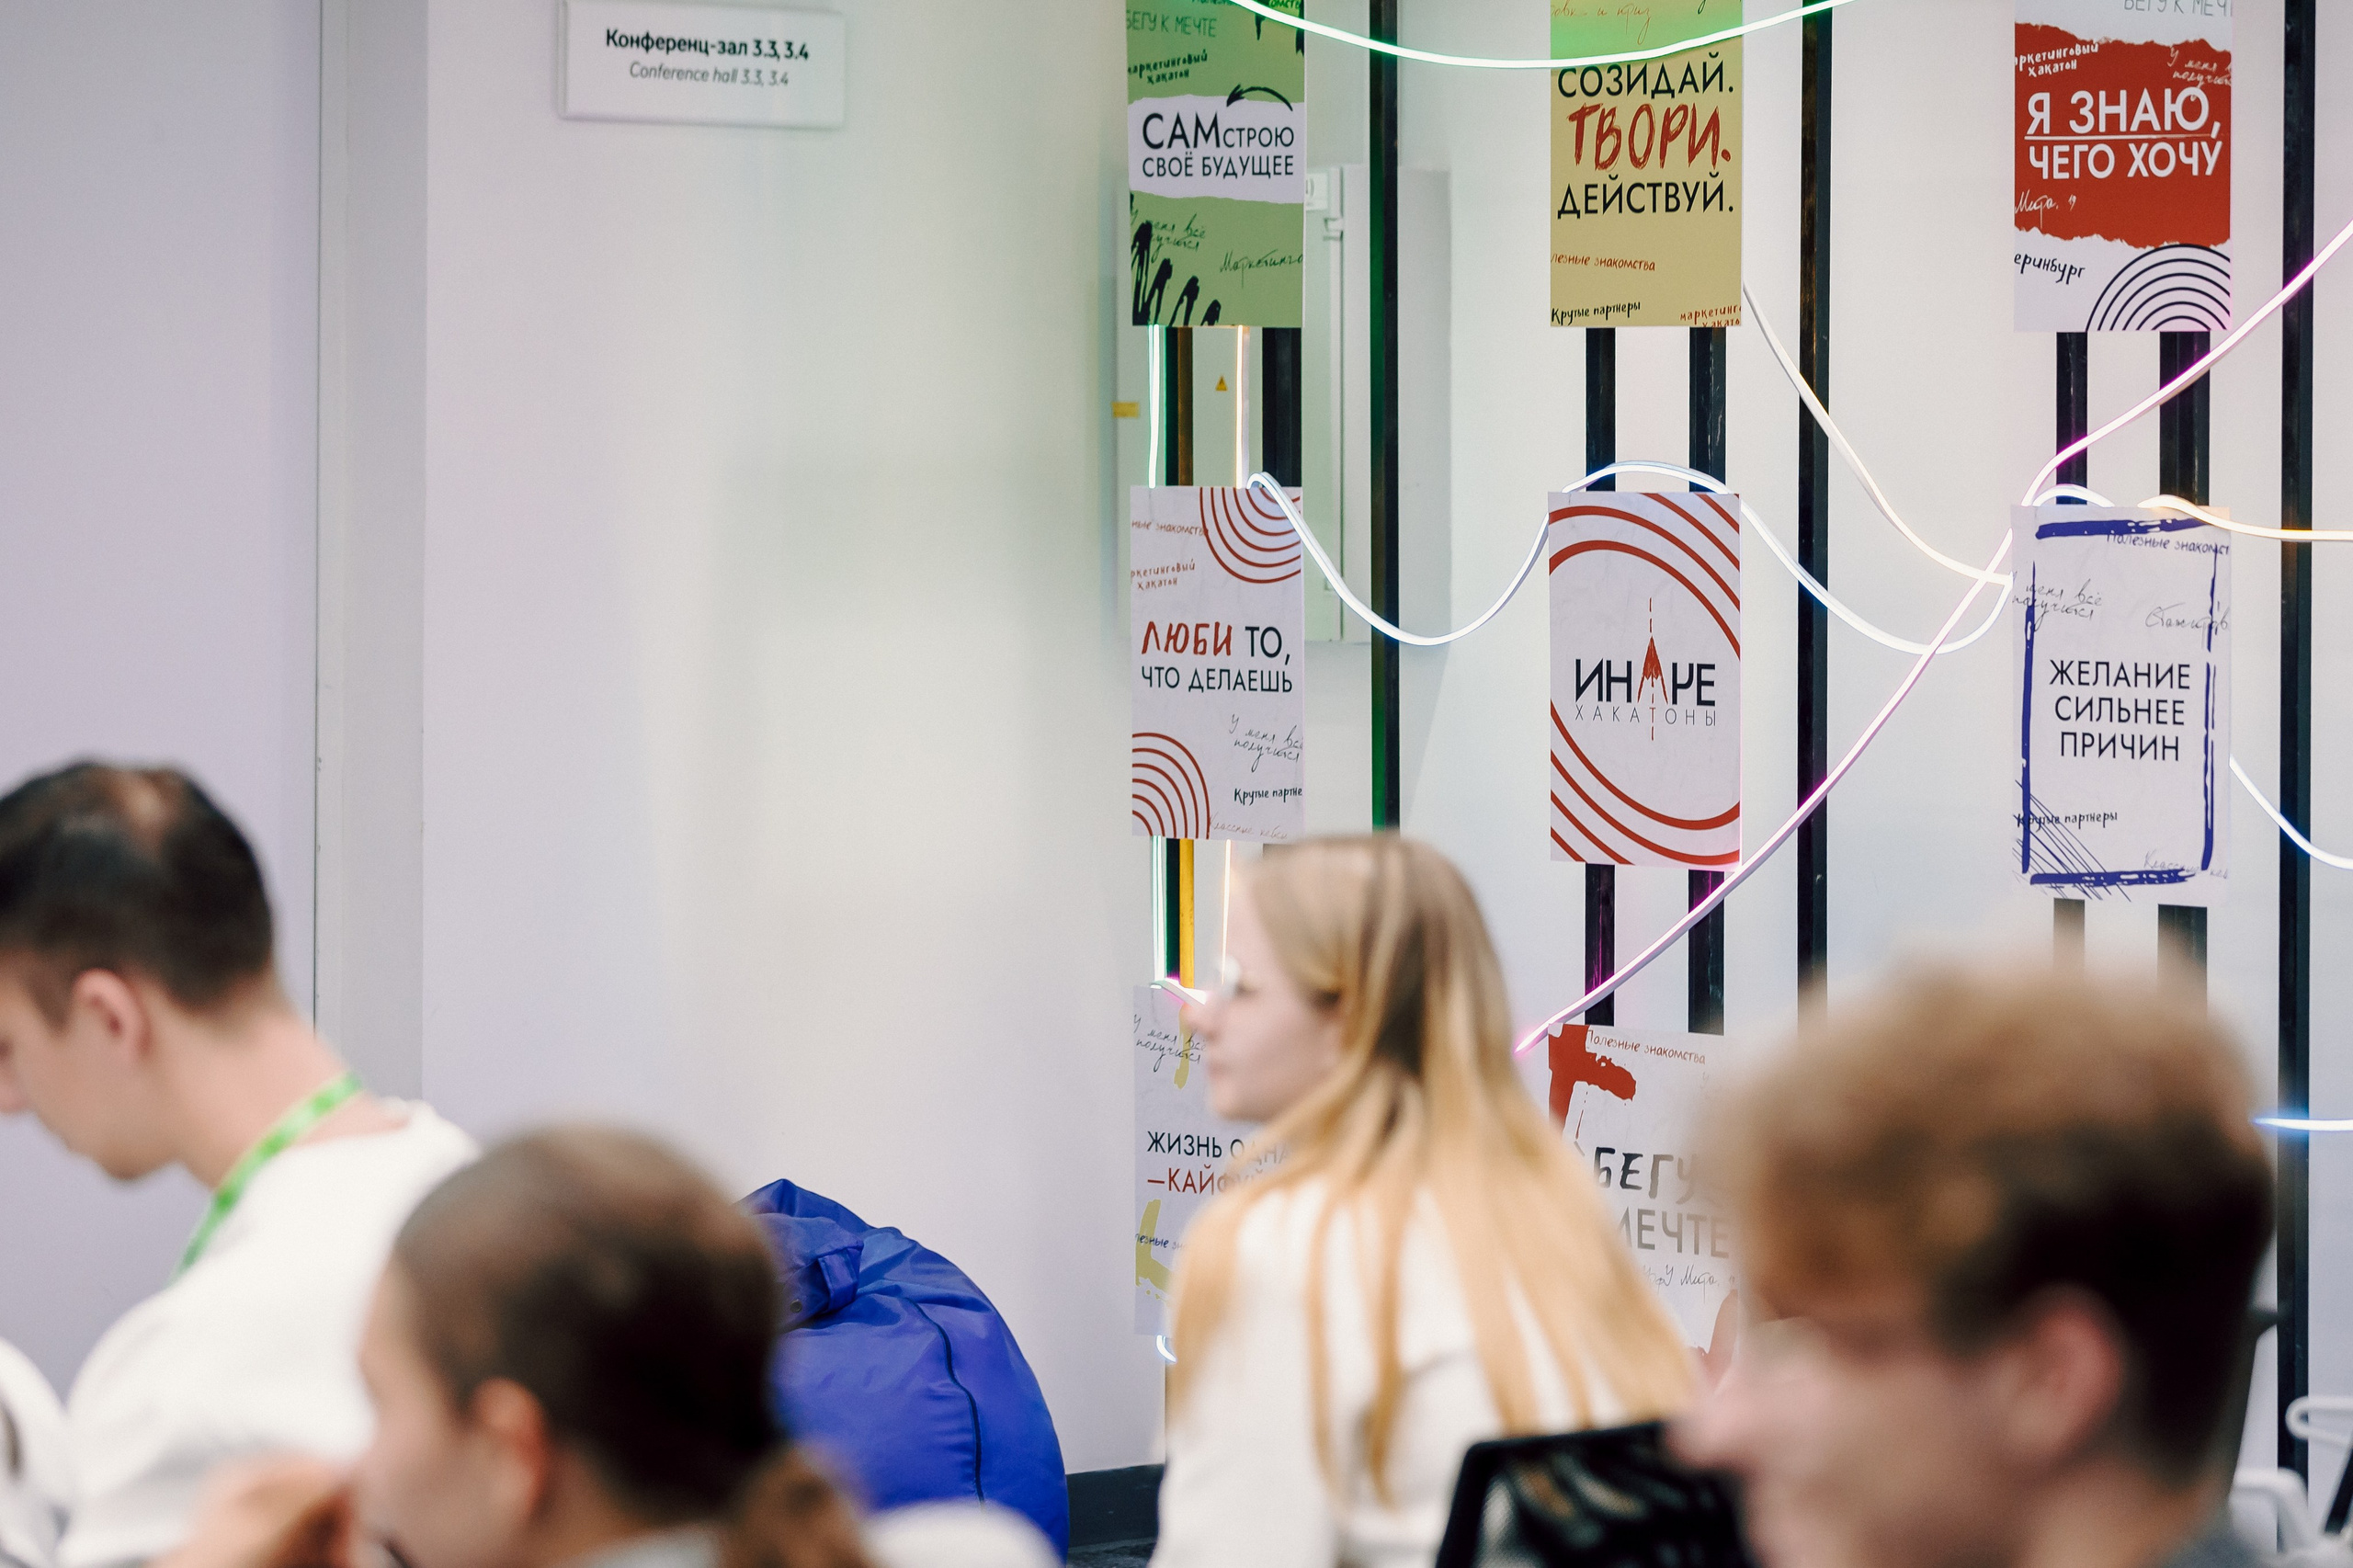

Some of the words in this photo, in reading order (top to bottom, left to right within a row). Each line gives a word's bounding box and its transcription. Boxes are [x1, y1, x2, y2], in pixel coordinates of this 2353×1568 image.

[1175, 16, 1217, 38] МЕЧТЕ
[606, 28, 747, 56] Конференц-зал
[784, 41, 809, 60] 3.4
[630, 61, 710, 82] Conference
[713, 67, 737, 84] hall
[768, 71, 789, 85] 3.4
[1147, 69, 1189, 85] хакатон
[1557, 51, 1734, 98] СОЗИДАЙ.
[2028, 59, 2077, 77] хакатон
[2027, 92, 2050, 134] Я
[2069, 86, 2221, 139] ЗНАЮ,
[1566, 102, 1732, 171] ТВОРИ.
[1142, 152, 1193, 177] СВОЁ
[1201, 155, 1293, 179] БУДУЩЕЕ
[2029, 143, 2115, 179] ЧЕГО
[2127, 141, 2222, 177] ХОЧУ
[1557, 172, 1734, 220] ДЕЙСТВУЙ.
[1594, 257, 1655, 271] знакомства
[2014, 253, 2086, 285] еринбург
[1552, 308, 1590, 326] Крутые
[1594, 301, 1641, 321] партнеры
[1137, 576, 1177, 591] хакатон
[1142, 620, 1233, 656] ЛЮБИ
[1245, 626, 1290, 665] ТО,
[1142, 666, 1180, 688] ЧТО
[1188, 668, 1292, 693] ДЕЛАЕШЬ
[2049, 660, 2190, 689] ЖЕЛАНИЕ
[1574, 704, 1716, 726] ХАКАТОНЫ
[2054, 695, 2185, 725] СИЛЬНЕЕ
[2061, 732, 2178, 761] ПРИЧИН
[1234, 788, 1269, 806] Крутые
[1272, 787, 1302, 803] партне
[2064, 812, 2118, 830] партнеры
[1588, 1030, 1640, 1052] Полезные
[1644, 1045, 1706, 1064] знакомства
[1147, 1131, 1222, 1158] ЖИЗНЬ
